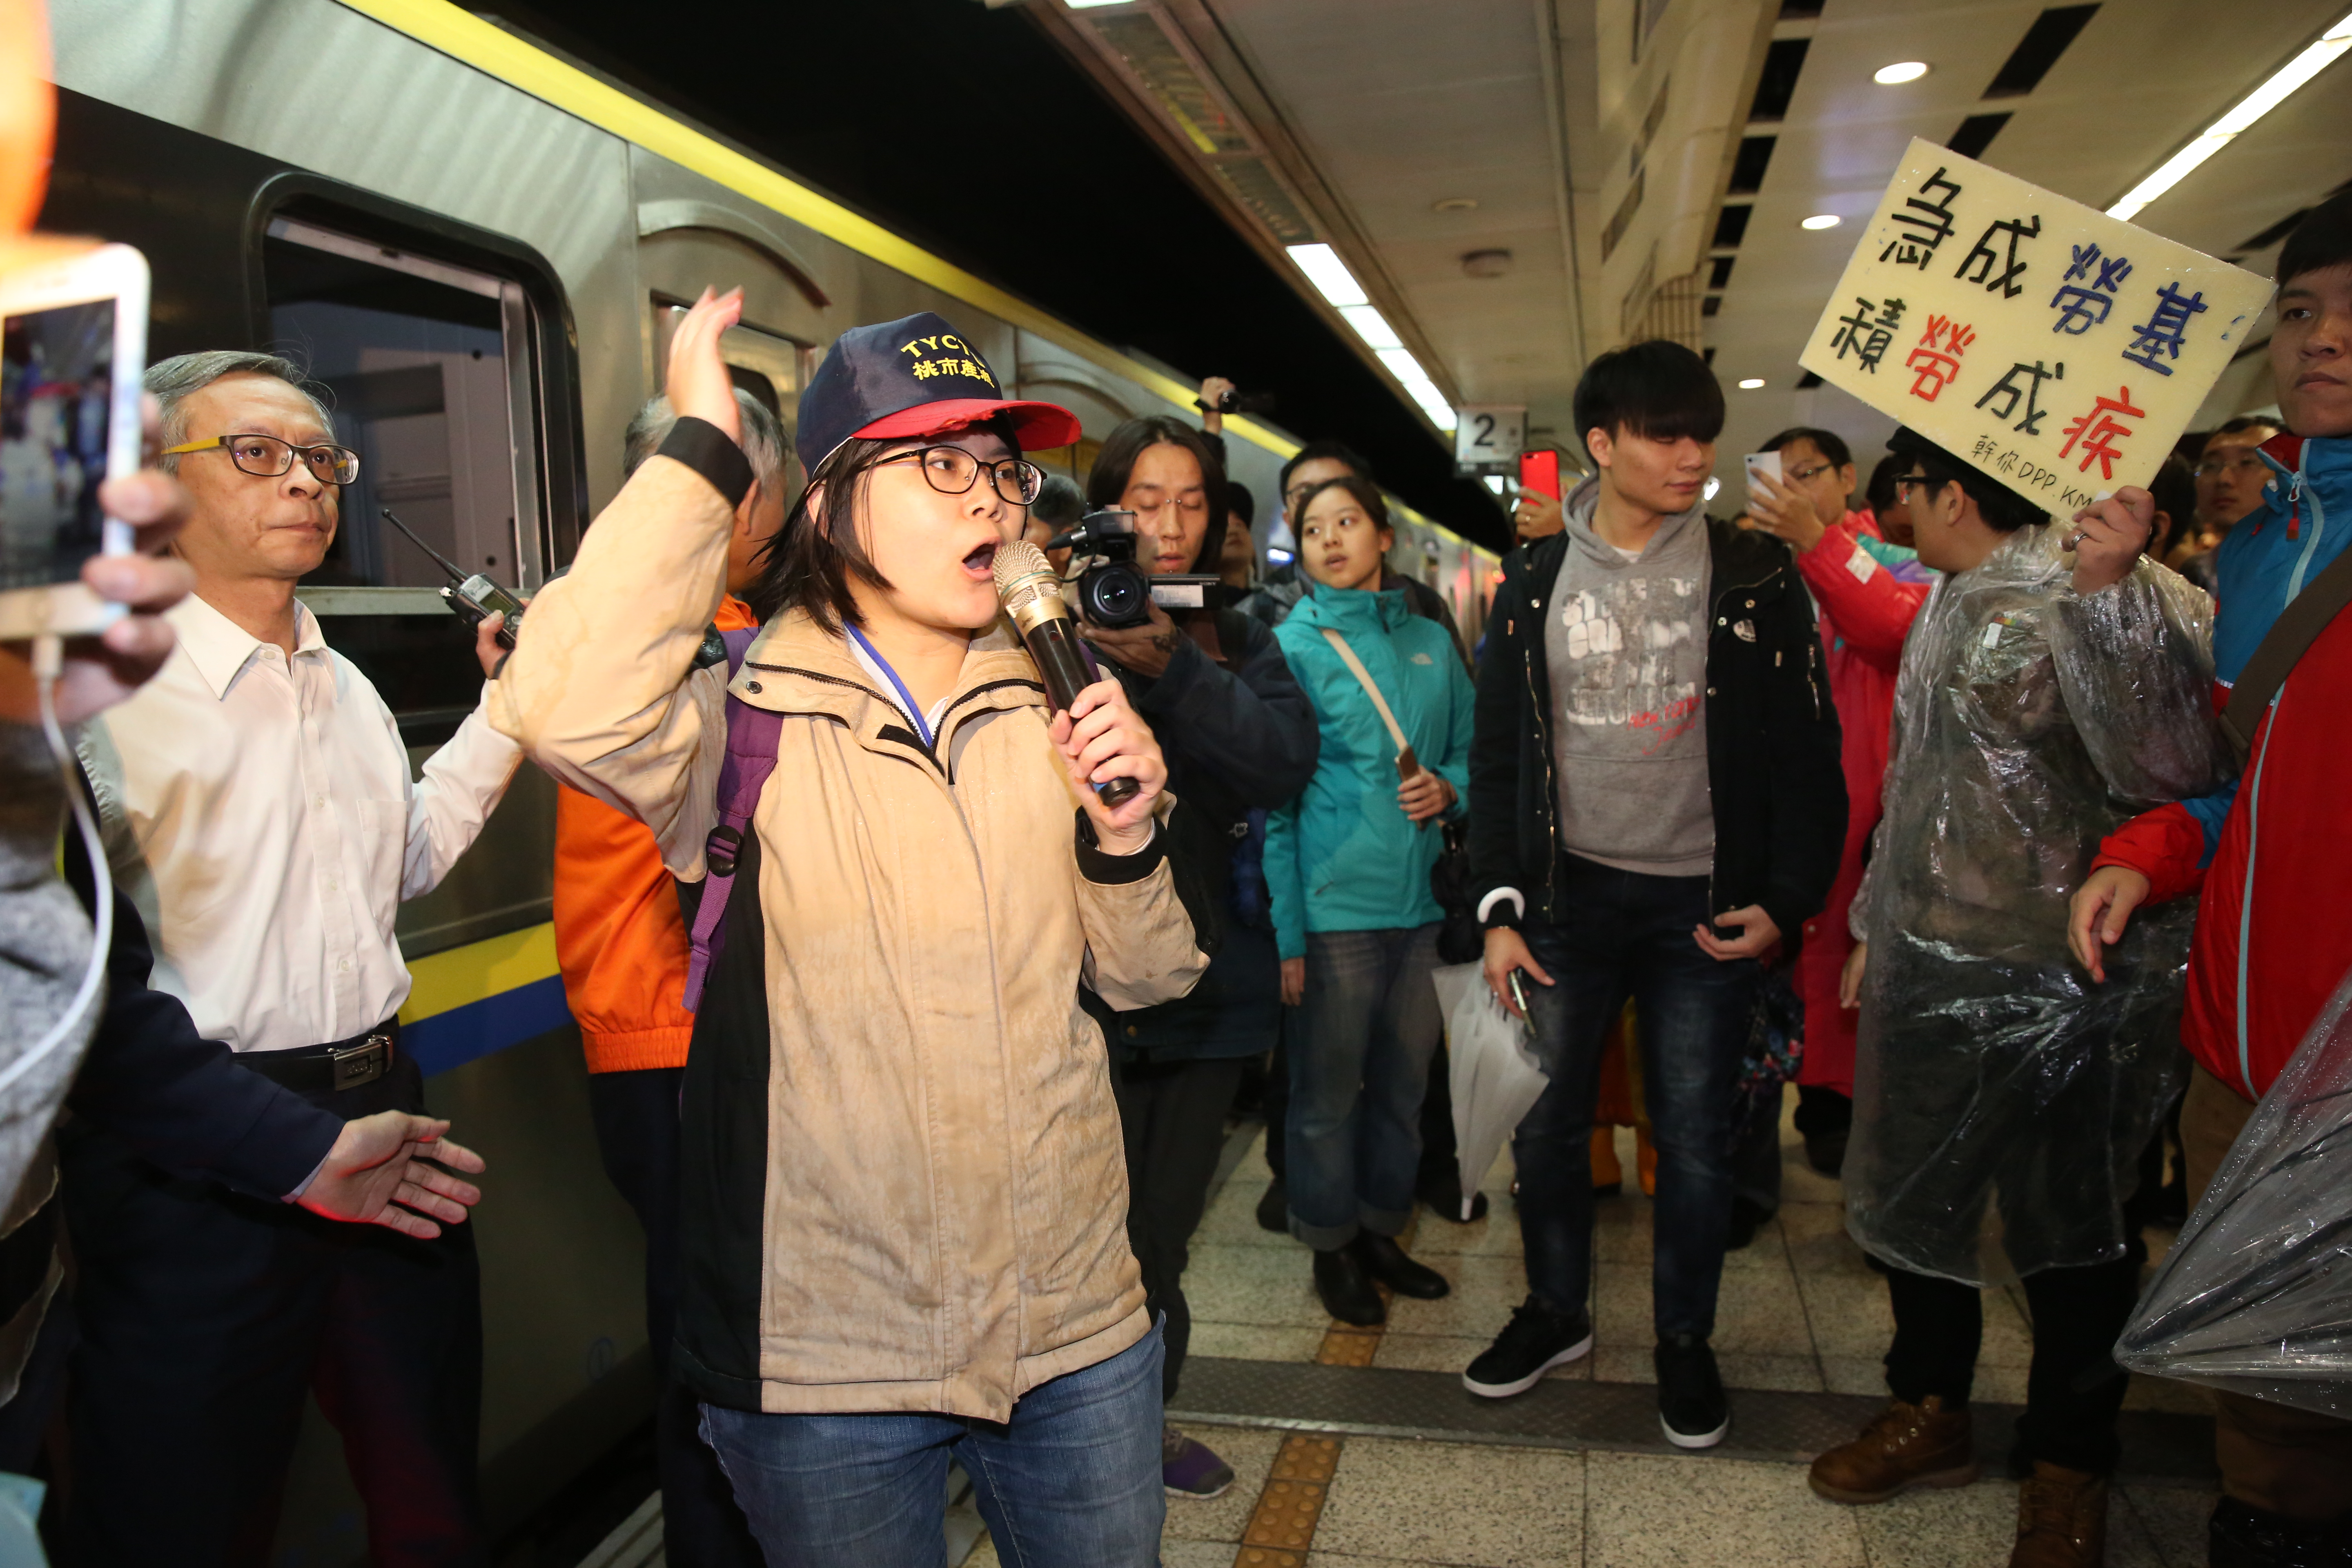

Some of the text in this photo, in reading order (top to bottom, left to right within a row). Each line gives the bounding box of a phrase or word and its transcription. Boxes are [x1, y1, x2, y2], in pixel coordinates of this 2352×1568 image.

[1879, 167, 2208, 376] 急成勞基
[1474, 414, 1495, 445] 2
[1830, 297, 2145, 480] 積勞成疾
